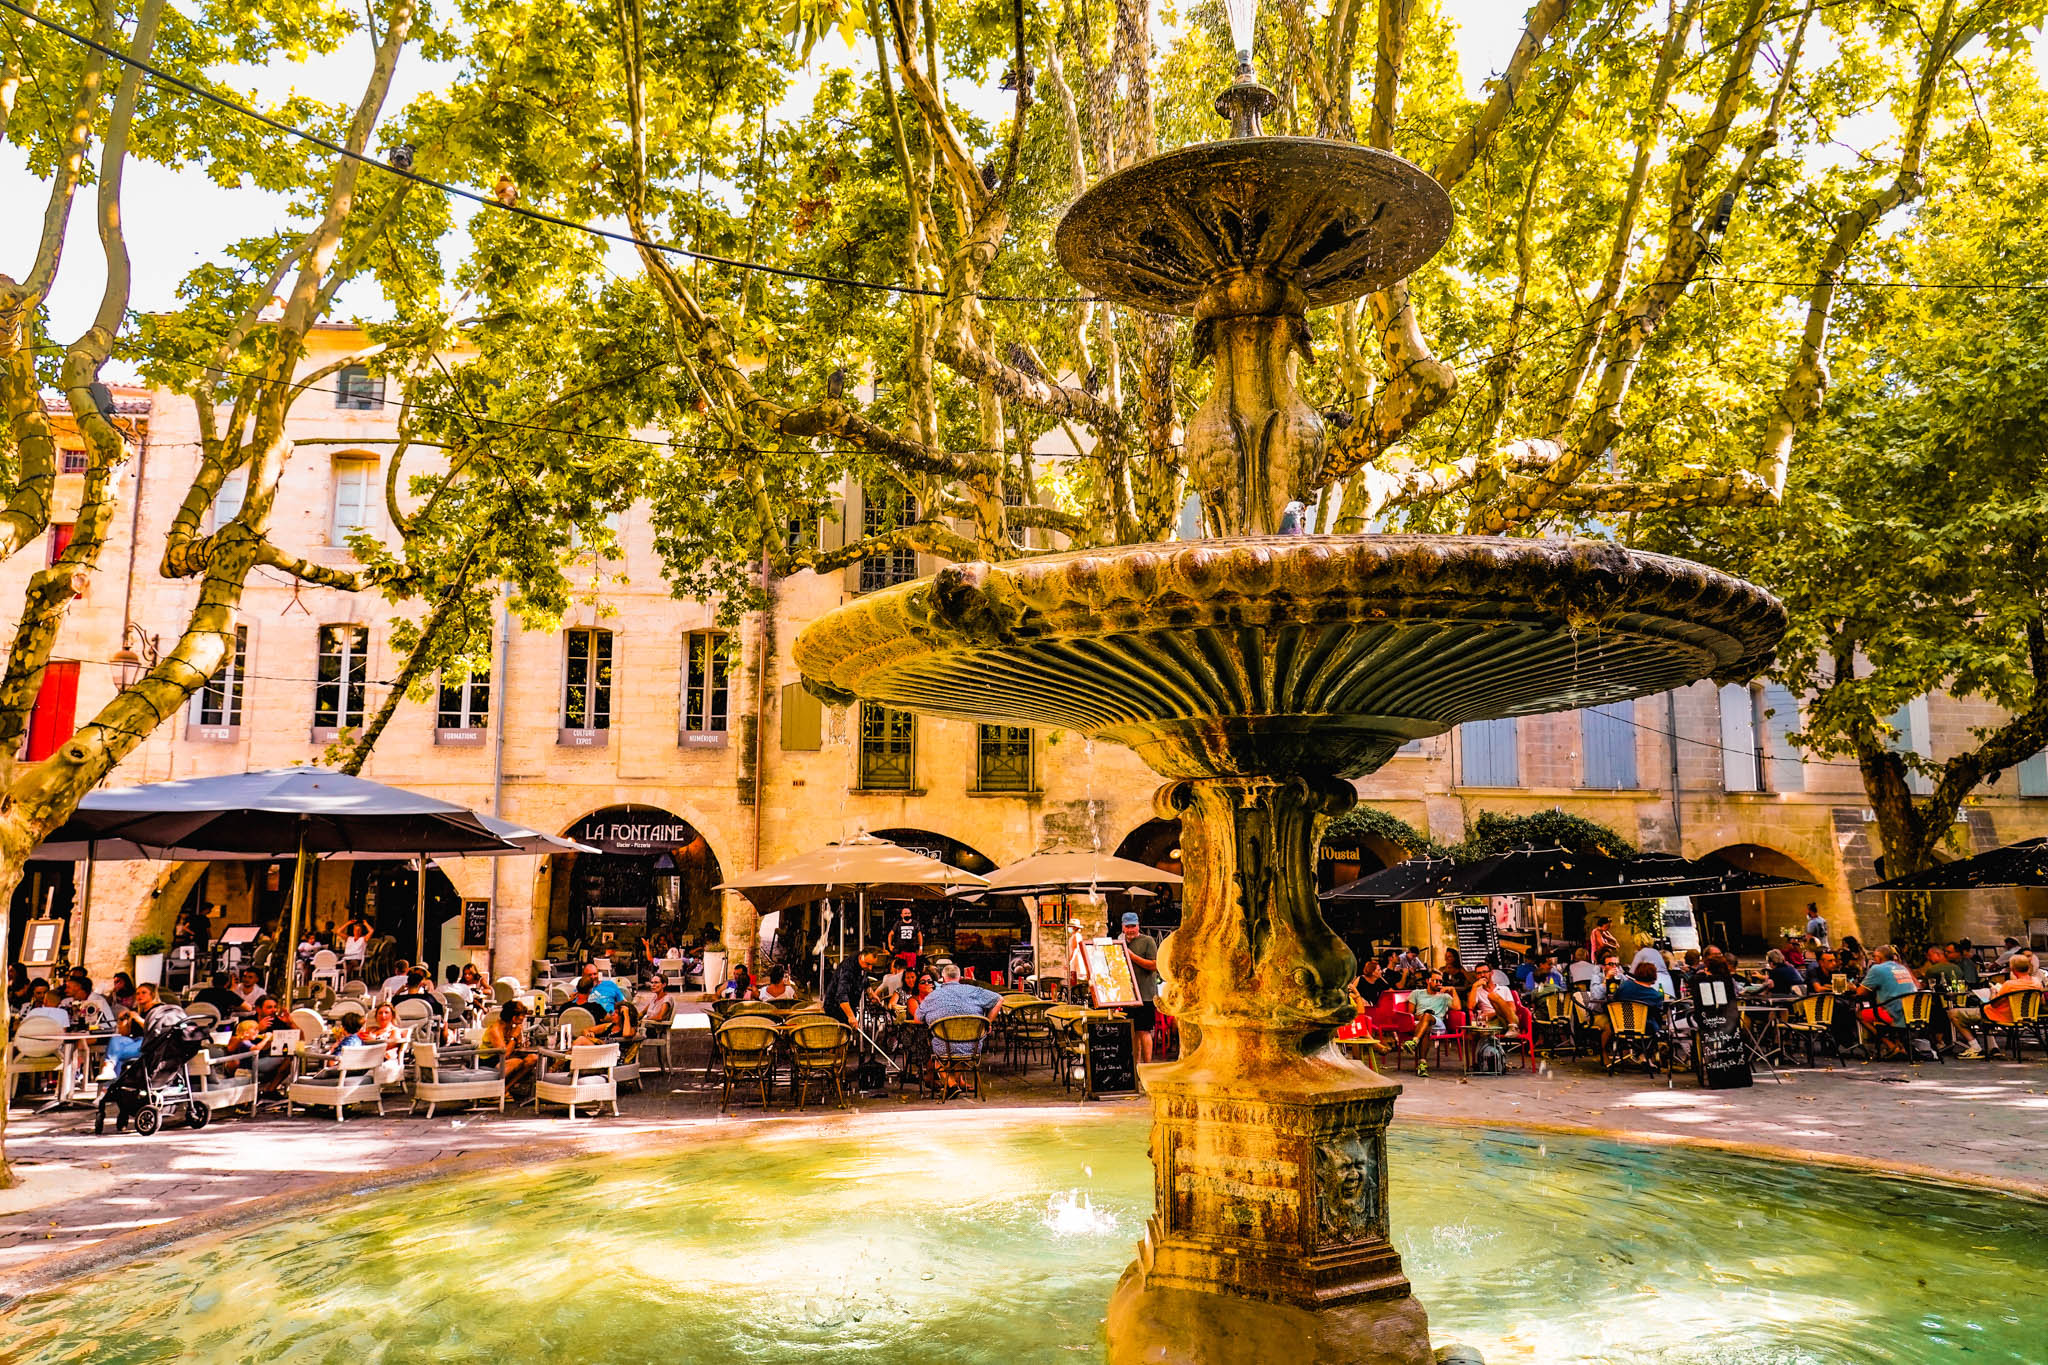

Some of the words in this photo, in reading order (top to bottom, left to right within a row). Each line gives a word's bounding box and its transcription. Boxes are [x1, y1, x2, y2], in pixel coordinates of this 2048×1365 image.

[443, 732, 477, 740] FORMATIONS
[572, 729, 596, 737] CULTURE
[575, 737, 592, 745] EXPOS
[689, 735, 719, 743] NUMÉRIQUE
[1862, 809, 1878, 822] LA
[586, 823, 604, 840] LA
[610, 824, 684, 841] FONTAINE
[1320, 846, 1360, 860] l'Oustal
[1462, 906, 1488, 914] l'Oustal
[900, 929, 913, 939] 23
